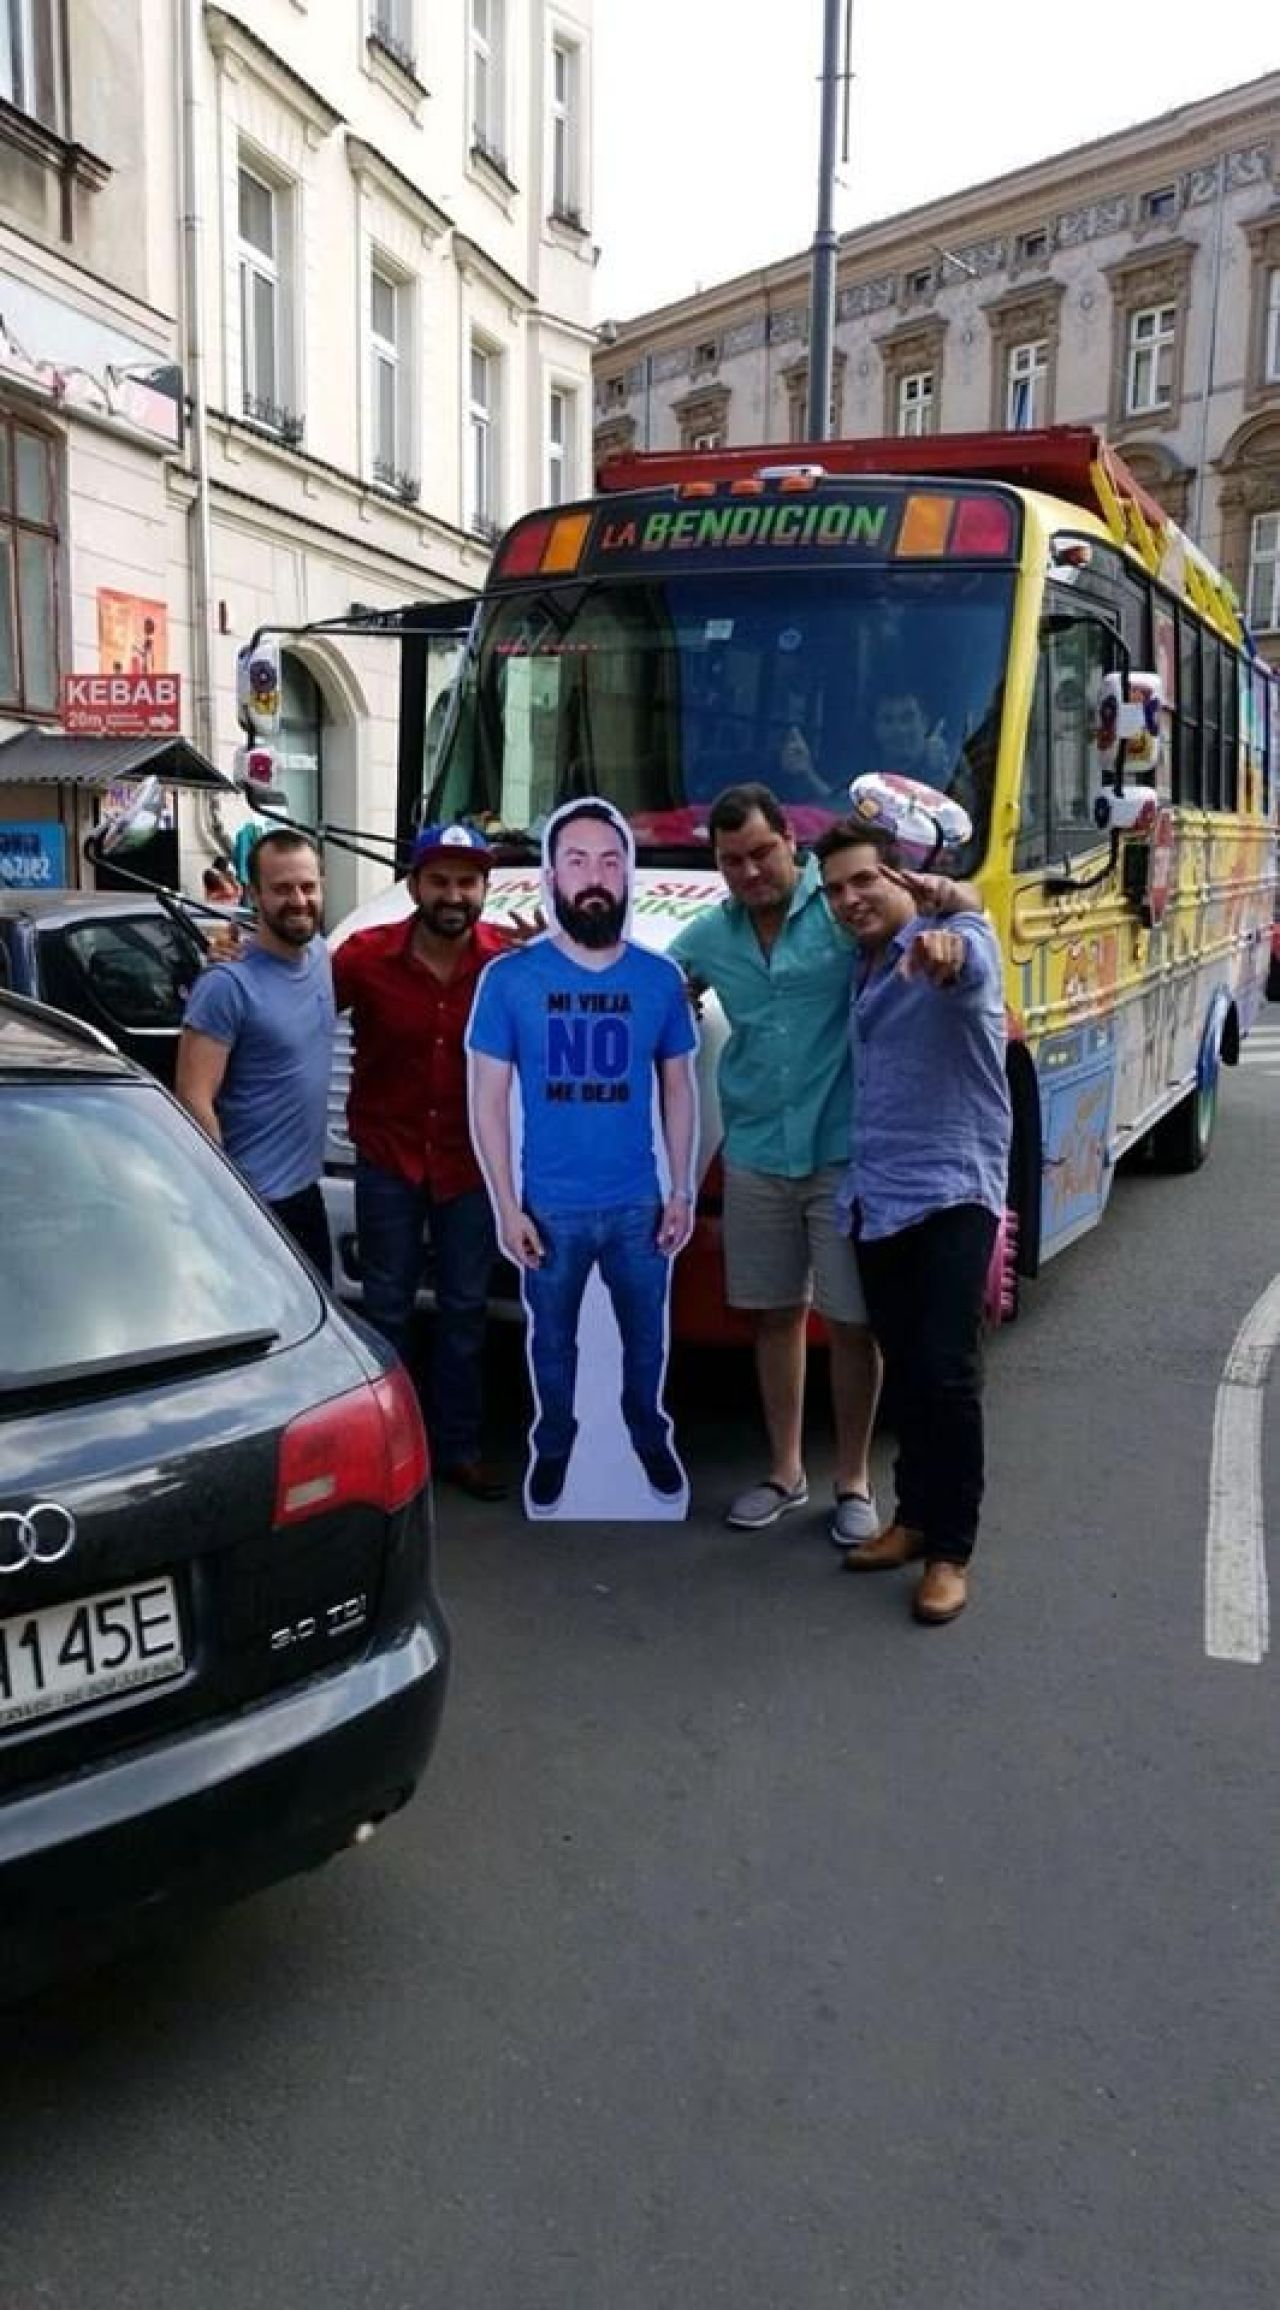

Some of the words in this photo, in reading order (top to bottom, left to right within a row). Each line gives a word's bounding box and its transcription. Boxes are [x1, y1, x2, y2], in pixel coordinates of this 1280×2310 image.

[602, 520, 636, 549] LA
[642, 503, 886, 551] BENDICION
[67, 680, 177, 706] KEBAB
[548, 992, 571, 1012] MI
[579, 992, 631, 1013] VIEJA
[547, 1017, 630, 1079] NO
[547, 1082, 574, 1102] ME
